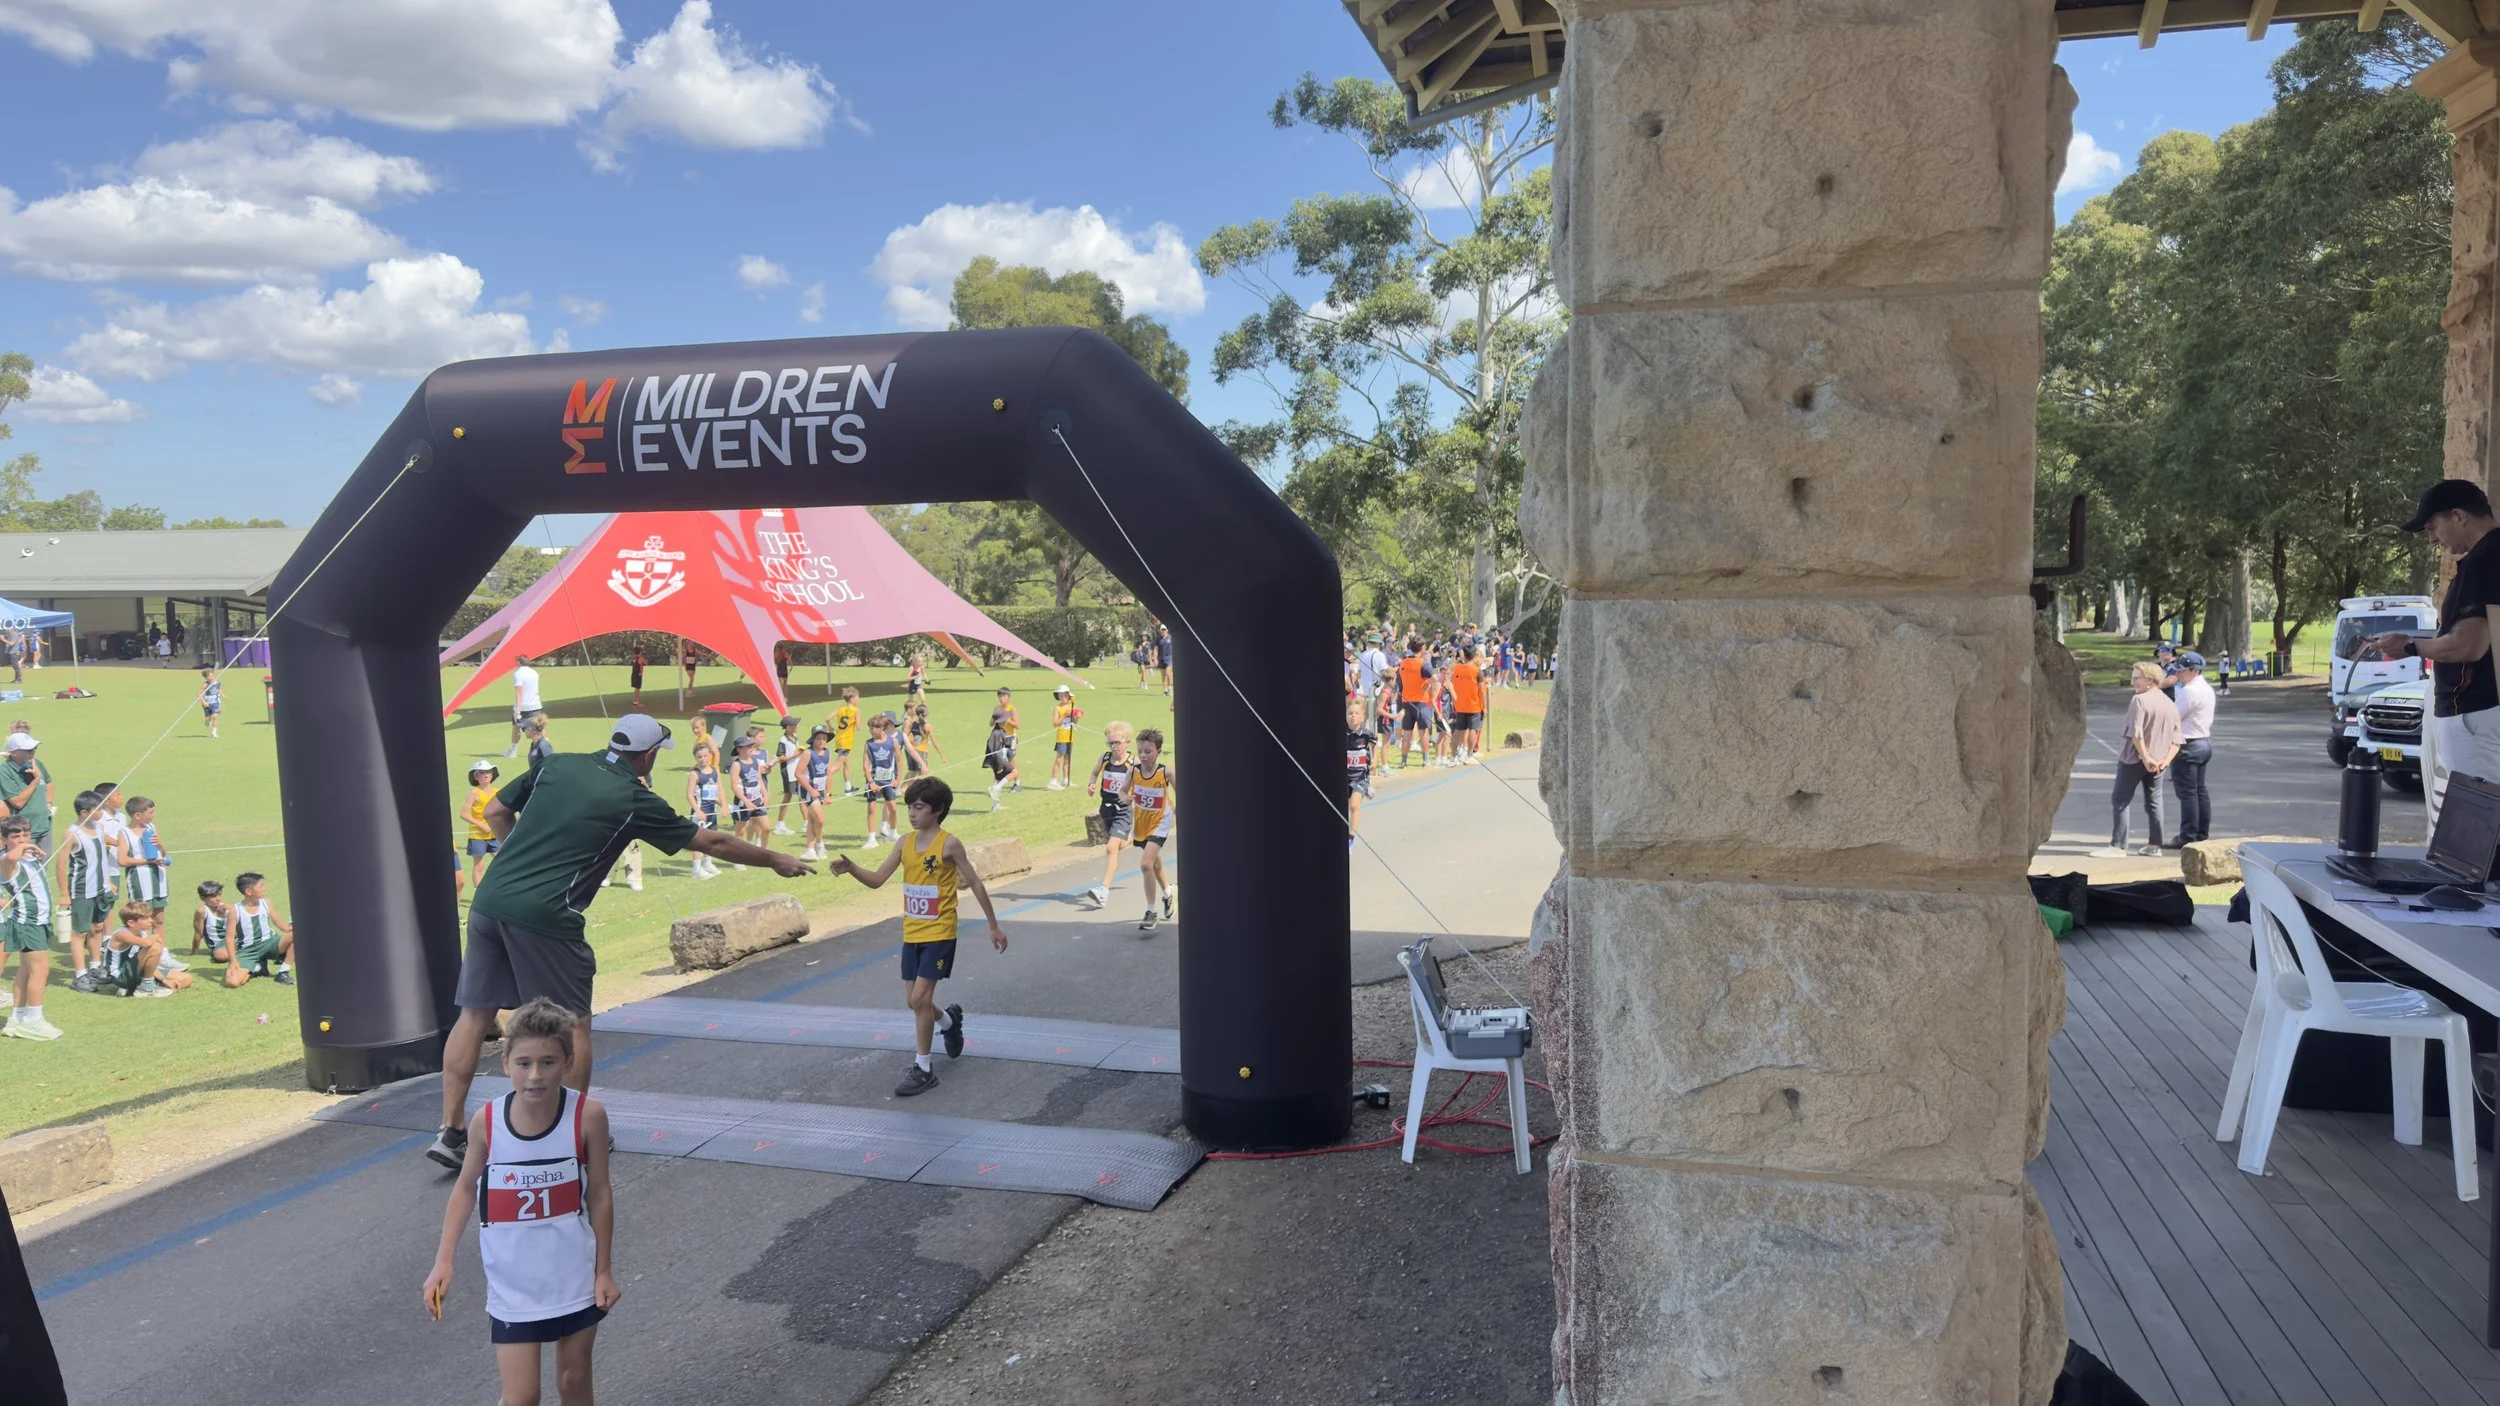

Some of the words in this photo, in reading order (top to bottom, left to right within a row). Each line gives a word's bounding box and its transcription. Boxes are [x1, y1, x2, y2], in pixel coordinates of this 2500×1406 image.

[633, 362, 898, 422] MILDREN
[632, 413, 868, 472] EVENTS
[758, 531, 812, 555] THE
[757, 555, 838, 581] KING'S
[764, 579, 865, 605] SCHOOL
[0, 617, 36, 630] OOL
[1109, 780, 1123, 792] 69
[1140, 796, 1155, 808] 59
[907, 898, 929, 915] 109
[521, 1170, 564, 1187] ipsha
[517, 1189, 550, 1220] 21
